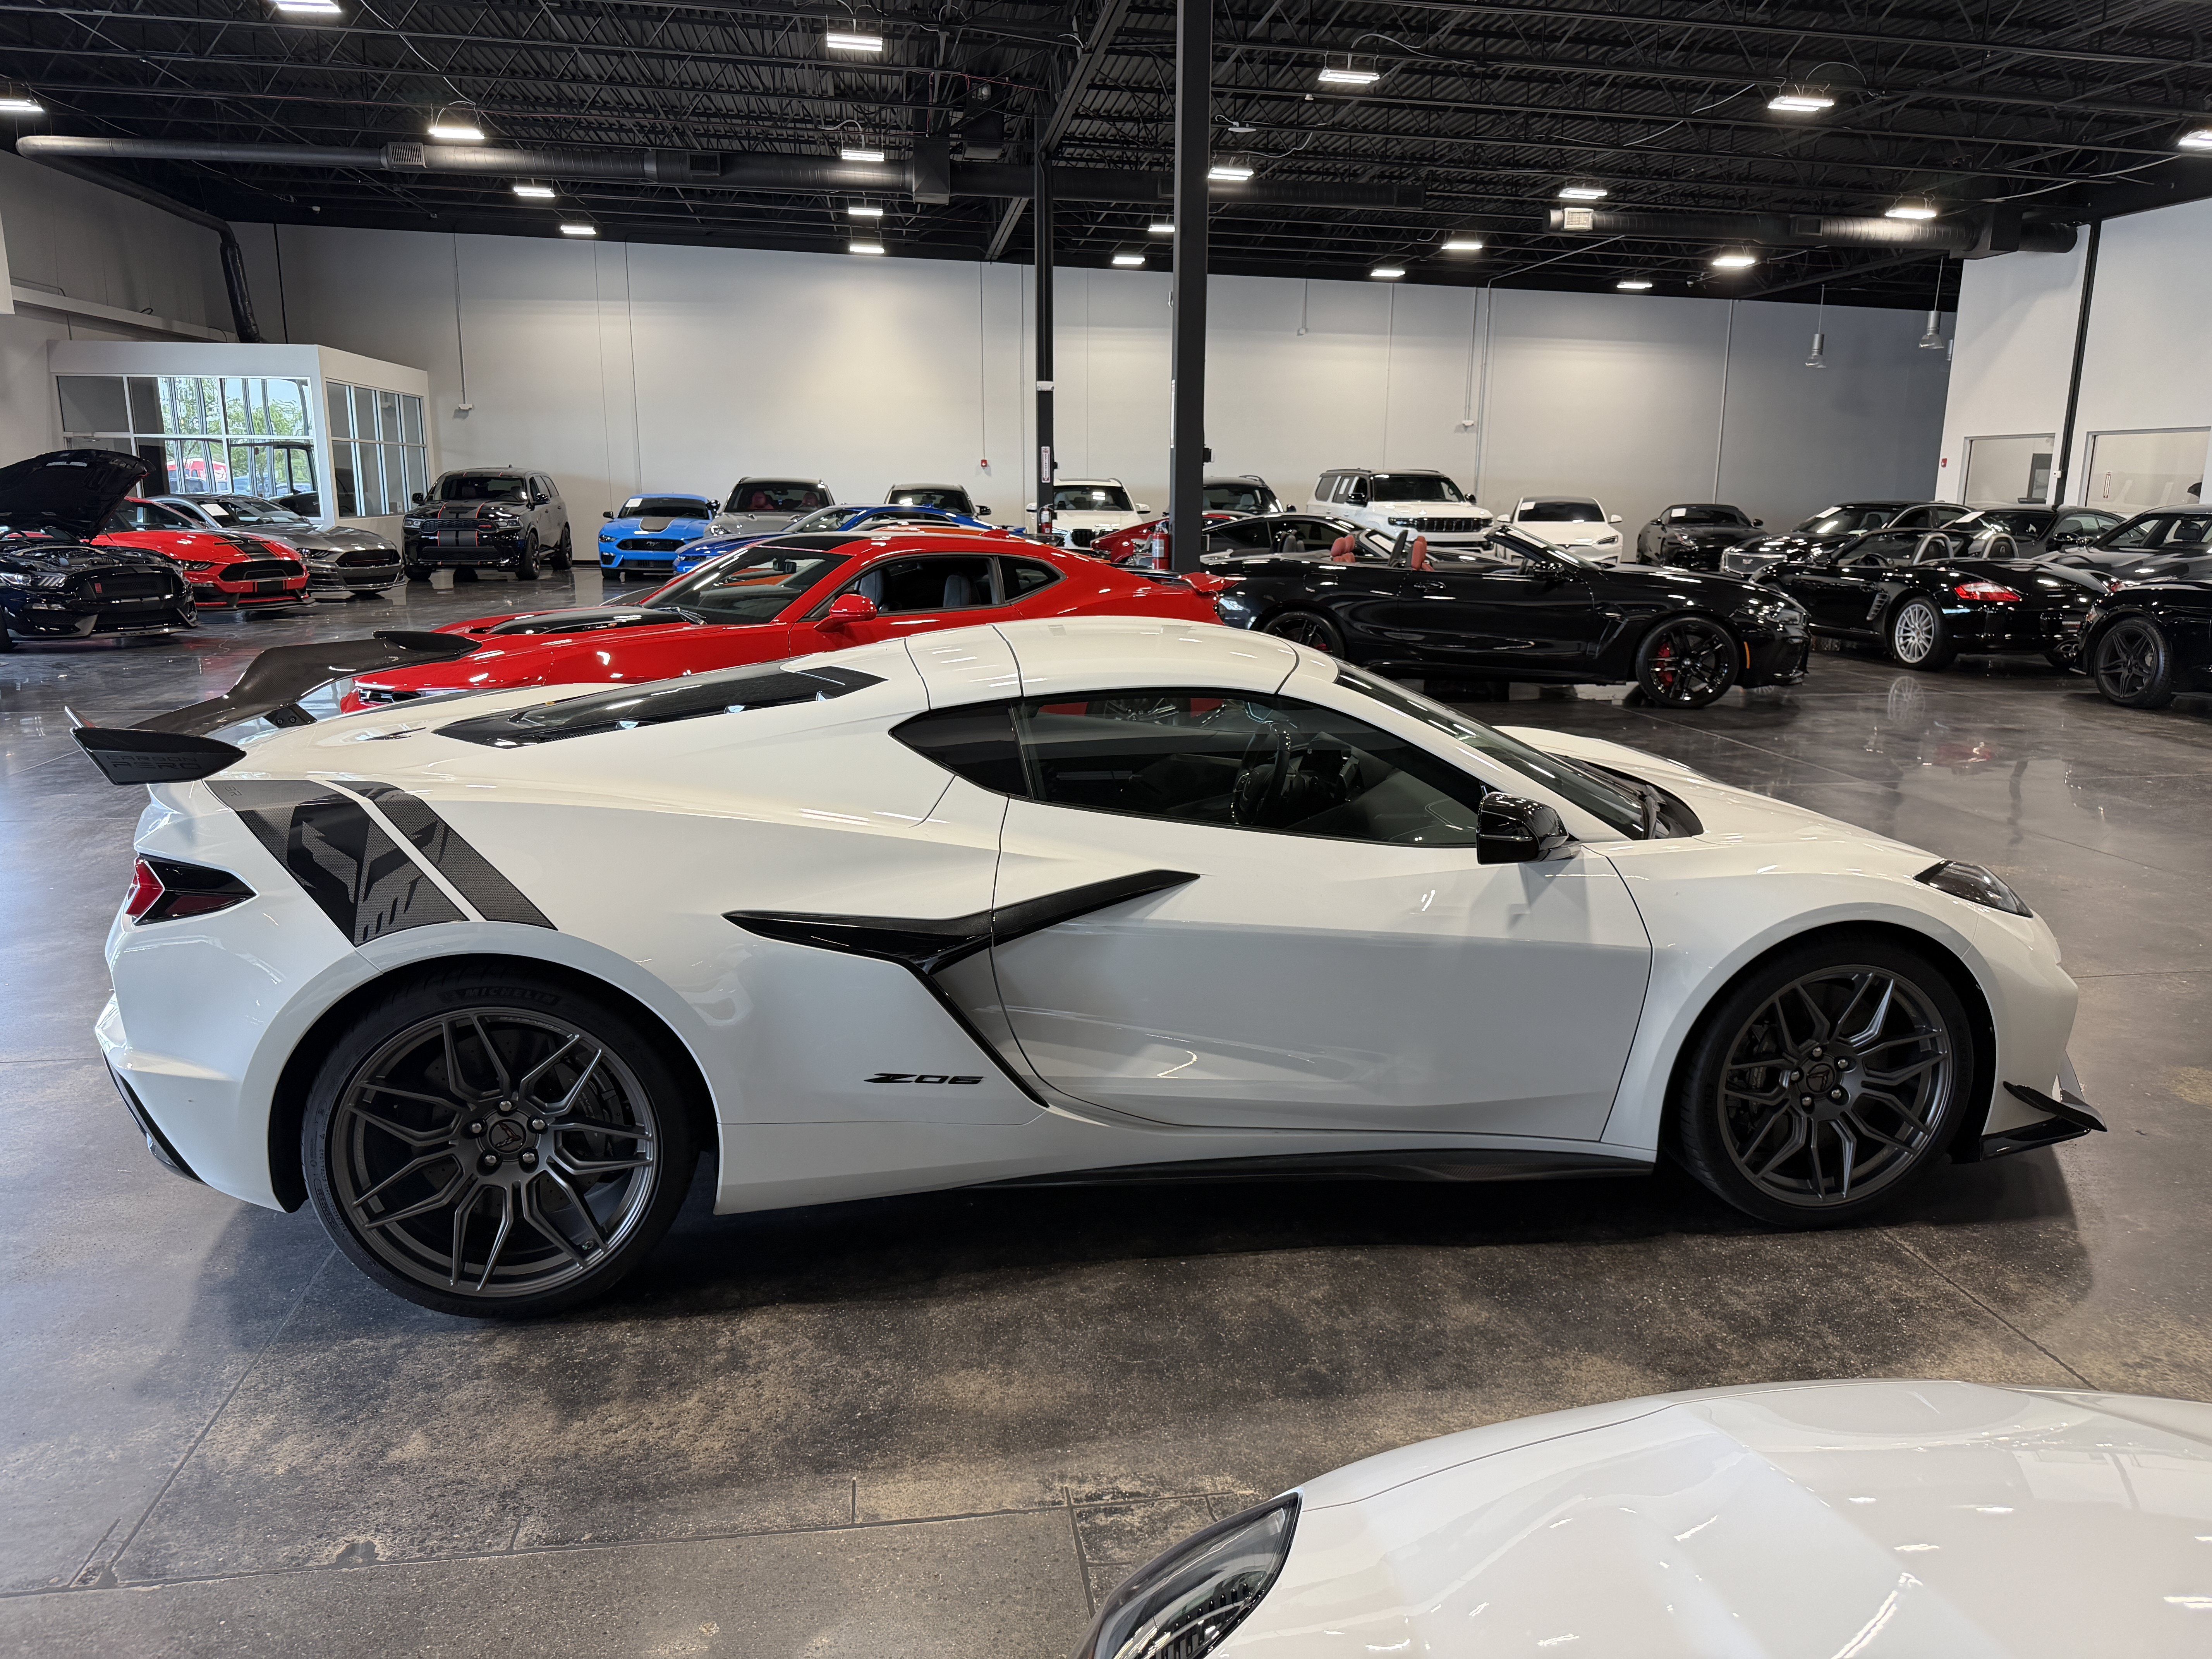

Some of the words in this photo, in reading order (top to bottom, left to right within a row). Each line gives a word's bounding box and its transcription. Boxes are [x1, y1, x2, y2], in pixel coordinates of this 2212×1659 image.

[110, 761, 202, 769] AERO
[463, 987, 557, 1005] MICHELIN
[863, 1073, 984, 1085] Z06
[356, 1127, 365, 1170] FORGED
